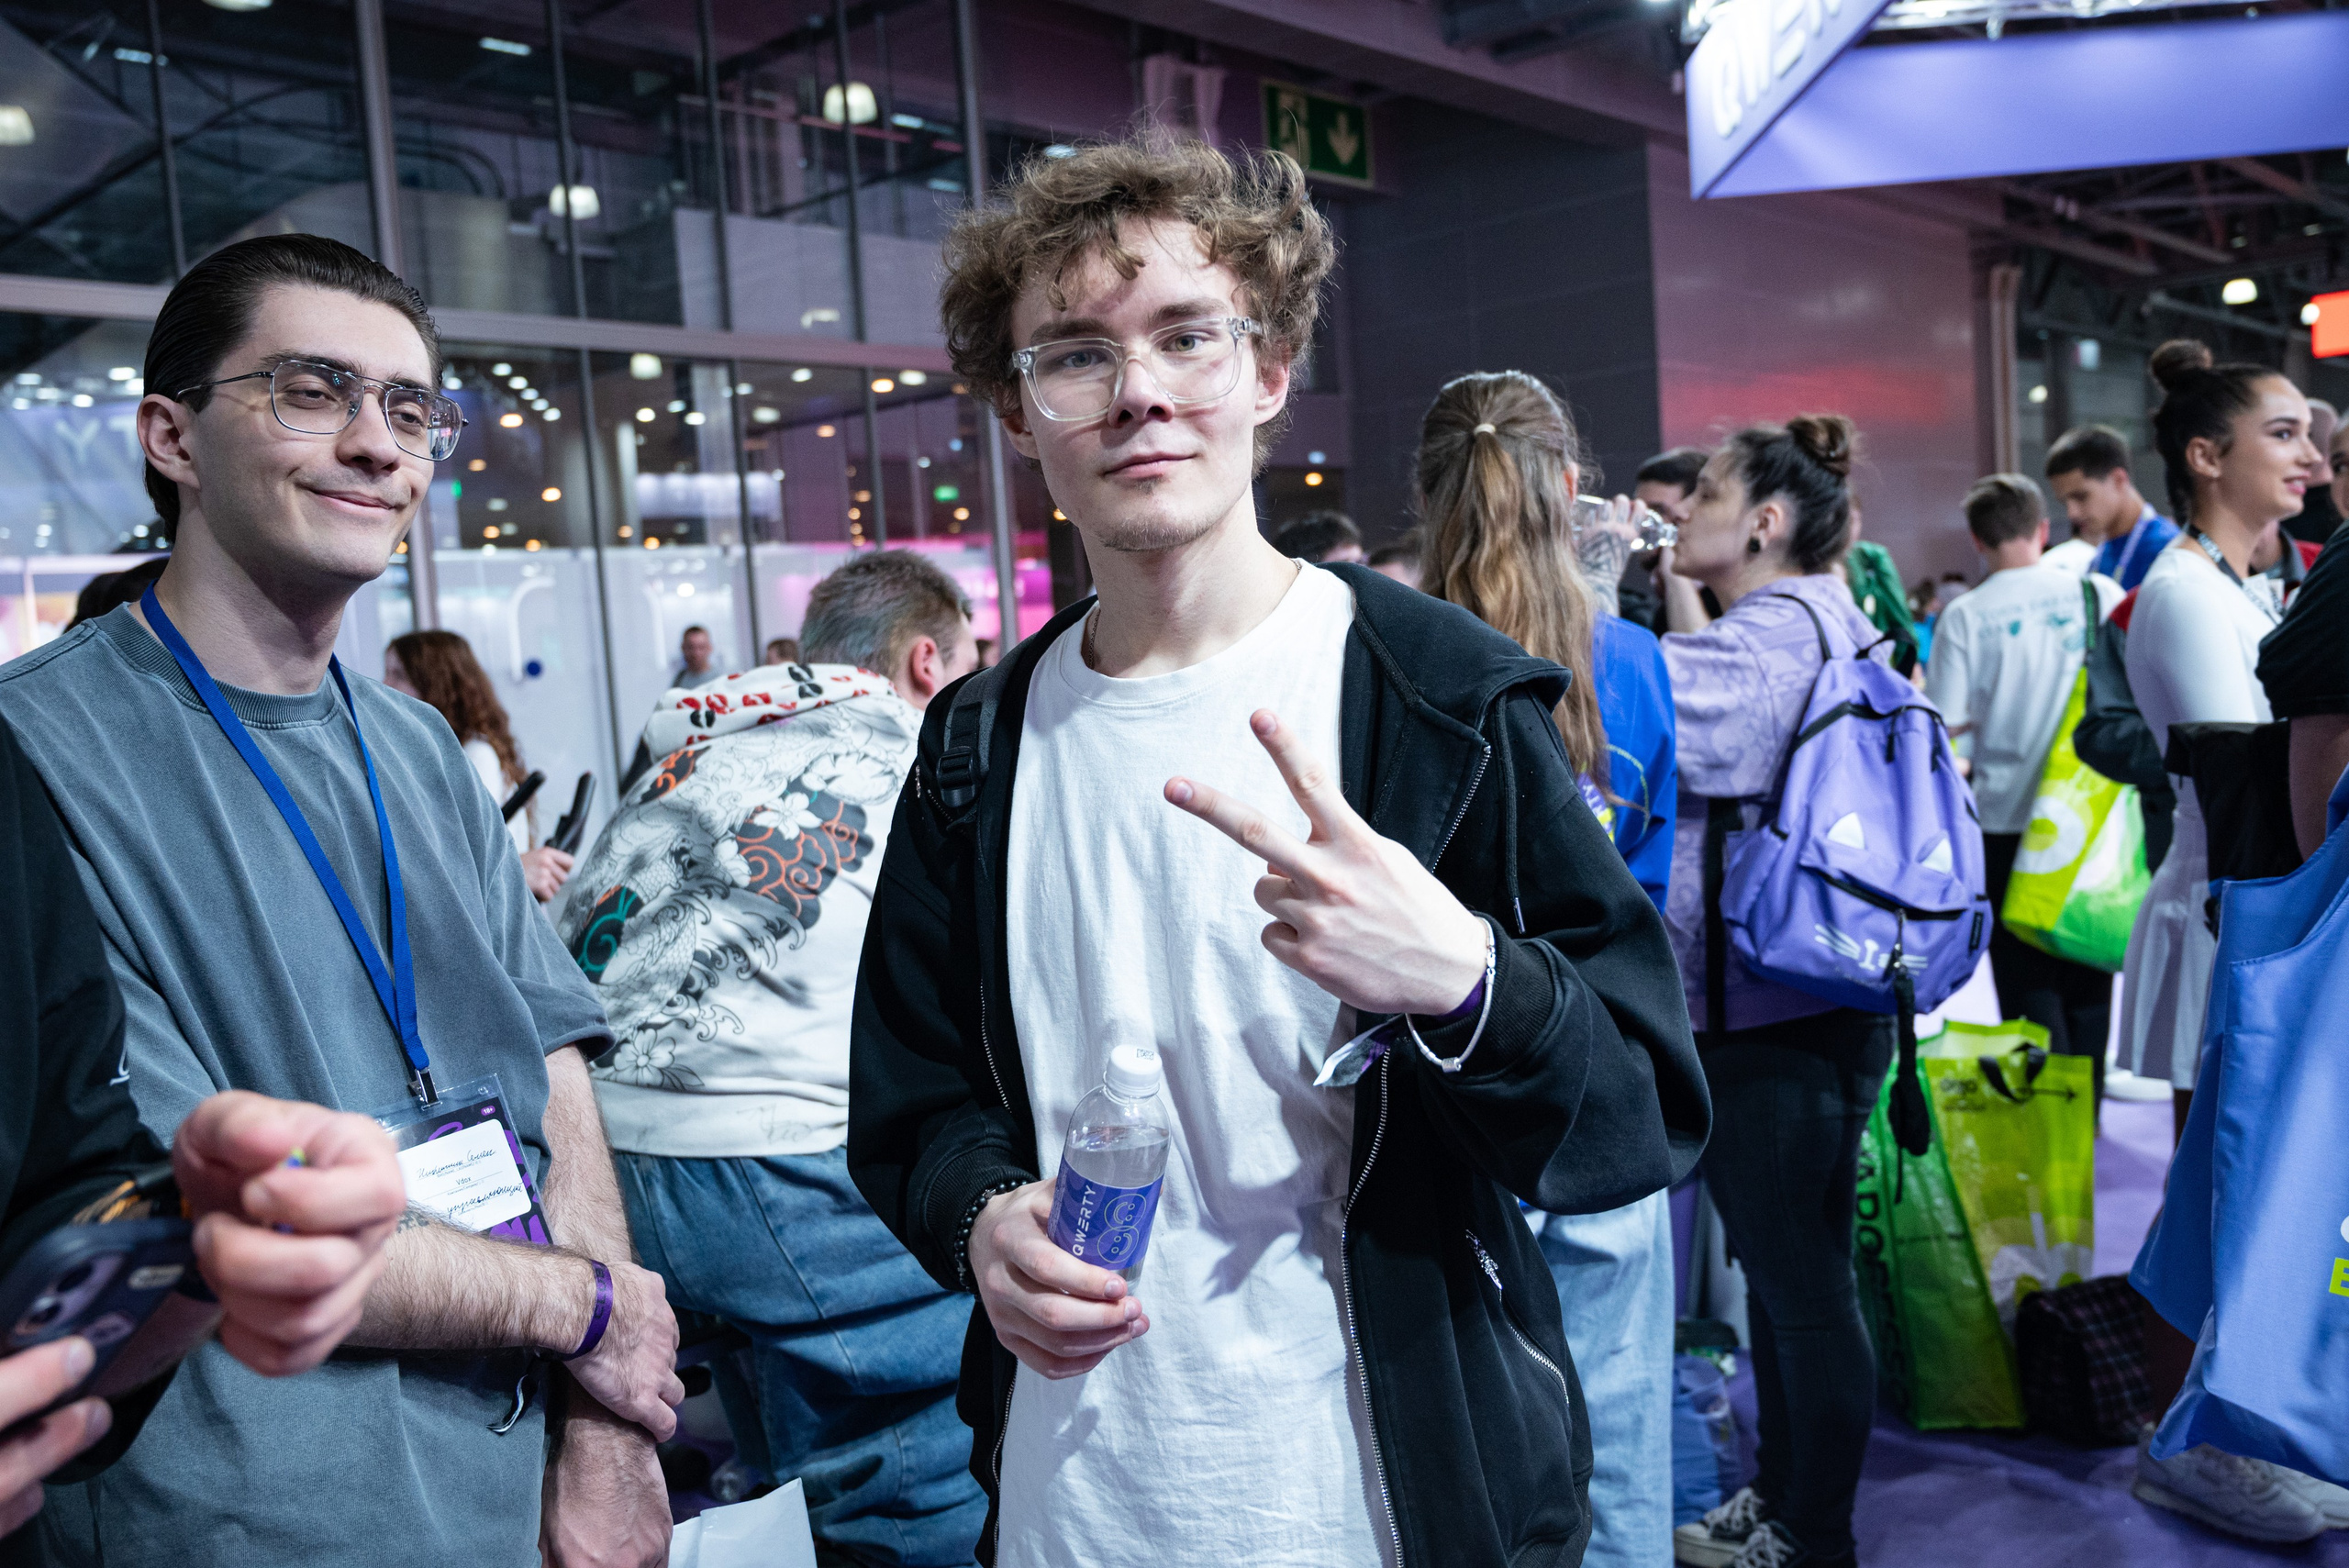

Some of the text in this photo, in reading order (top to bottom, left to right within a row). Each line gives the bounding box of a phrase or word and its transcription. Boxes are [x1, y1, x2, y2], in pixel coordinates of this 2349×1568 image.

[483, 1106, 495, 1115] 18+
[455, 1176, 472, 1185] Vdox
[1072, 1184, 1097, 1256] QWERTY
